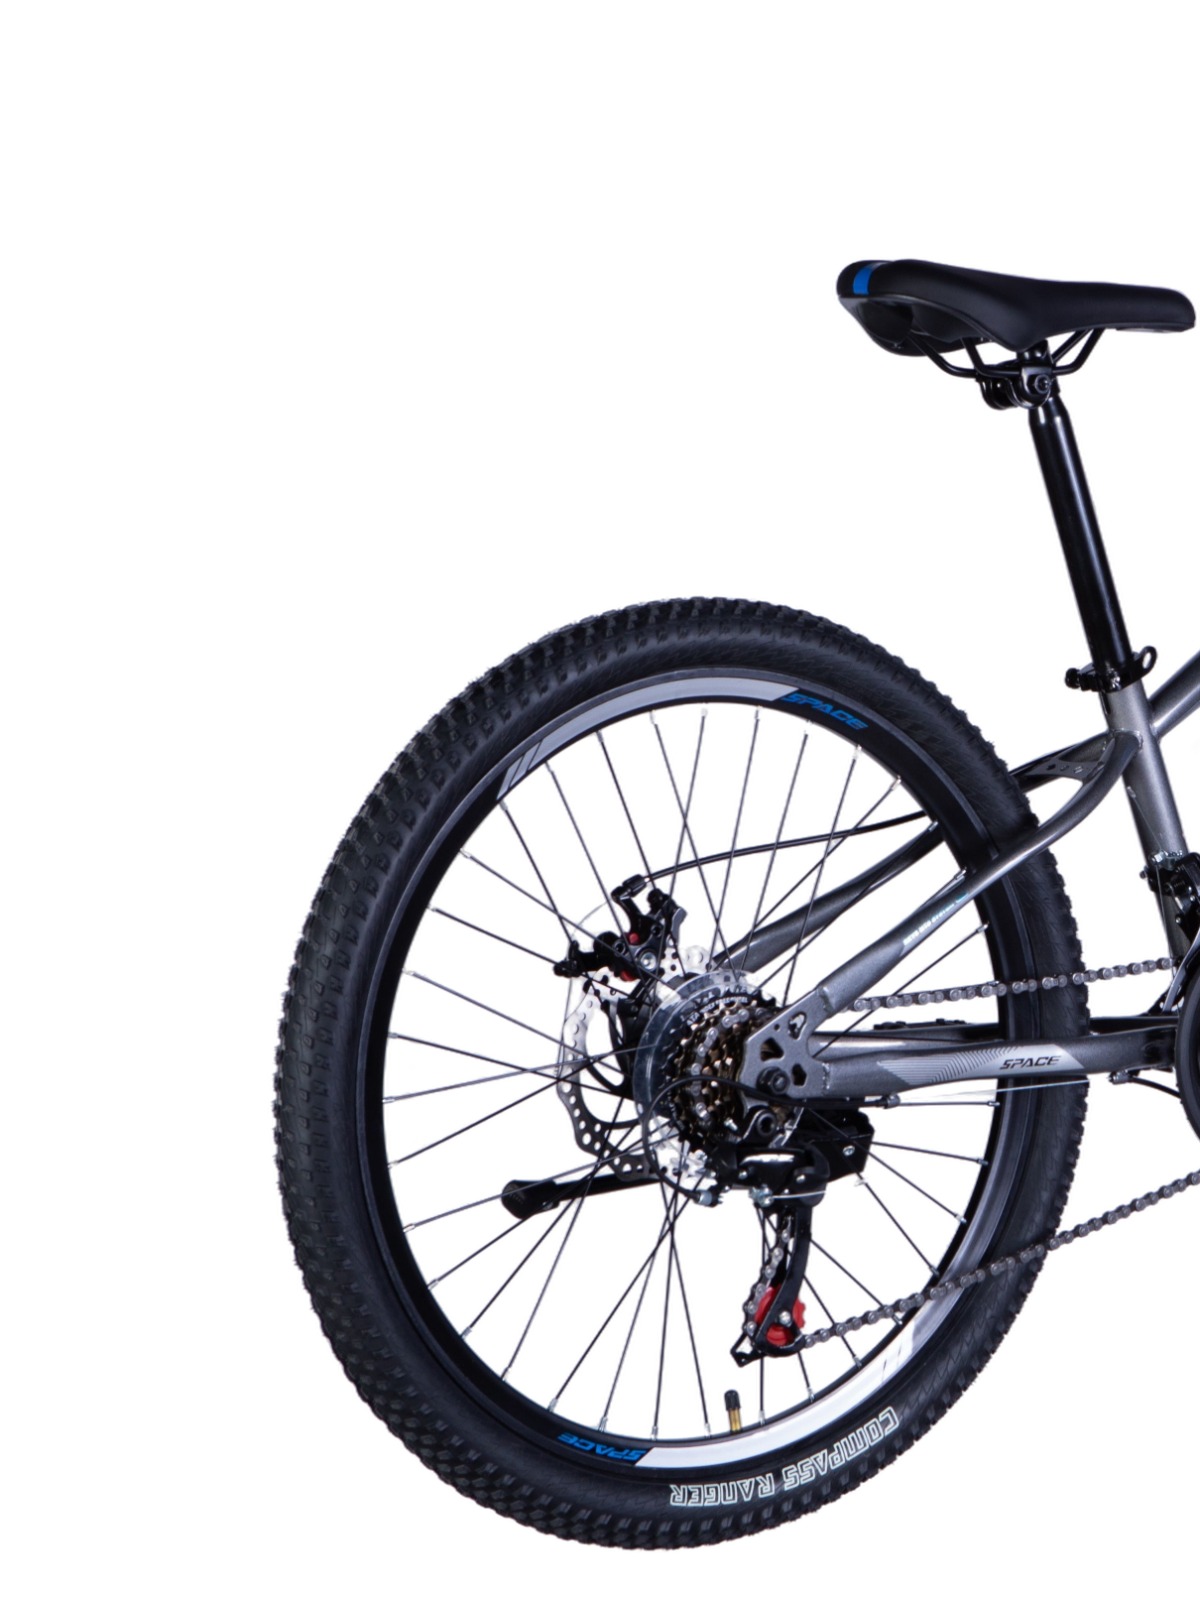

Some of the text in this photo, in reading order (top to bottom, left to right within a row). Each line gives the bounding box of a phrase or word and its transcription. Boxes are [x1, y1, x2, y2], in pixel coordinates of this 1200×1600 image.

[782, 694, 868, 730] SPACE
[1000, 1055, 1061, 1070] SPACE
[557, 1432, 645, 1461] SPACE
[669, 1406, 899, 1507] COMPASS RANGER
